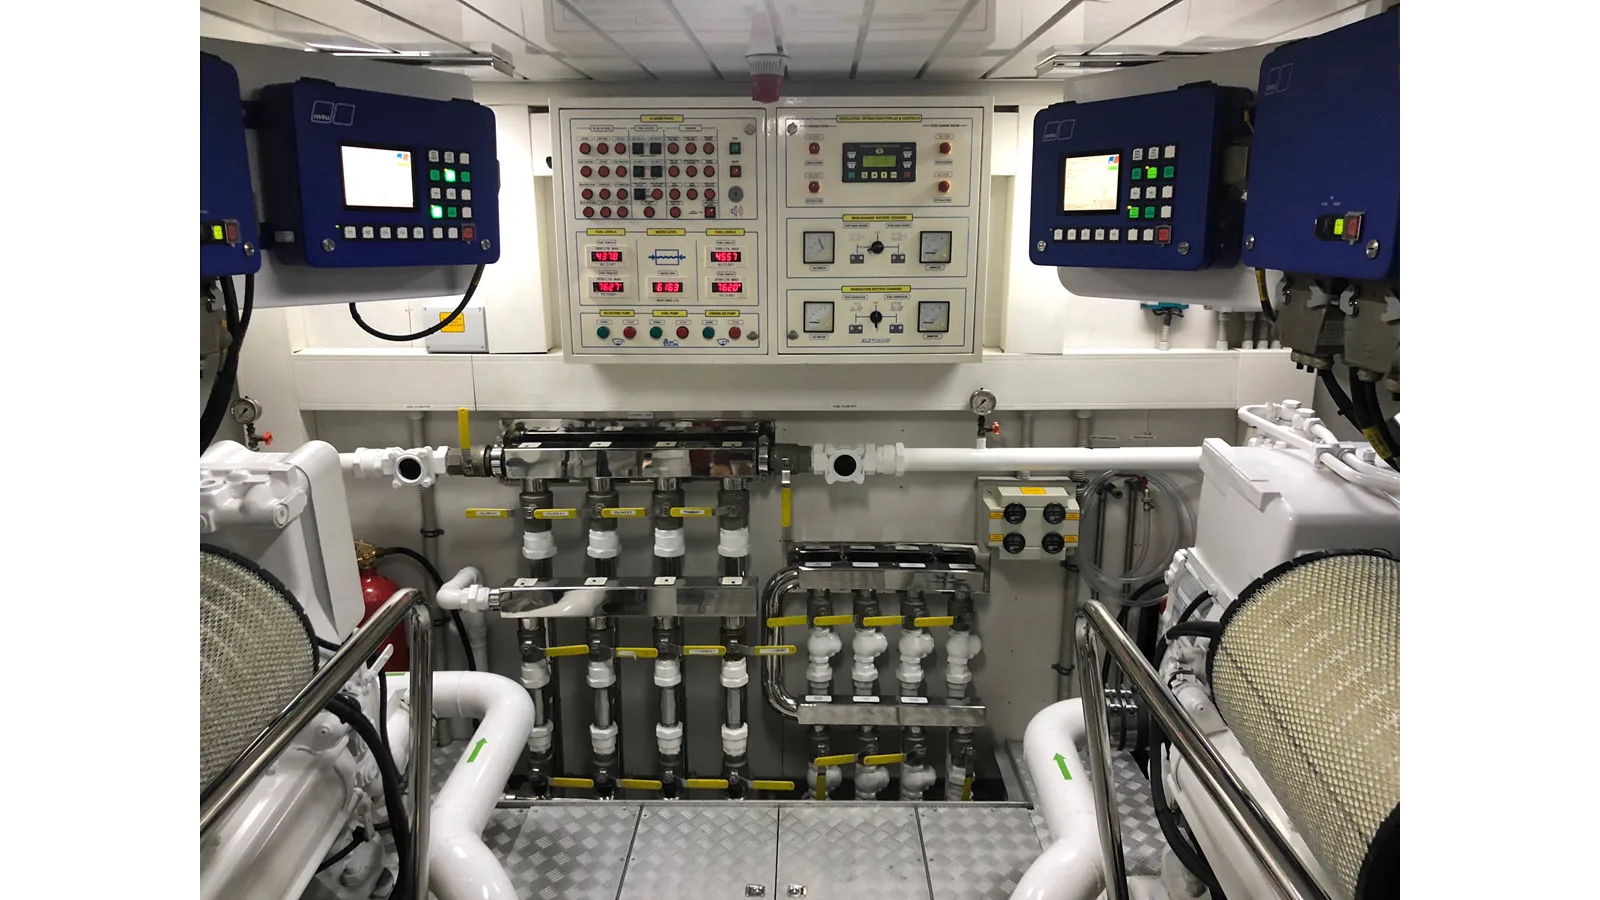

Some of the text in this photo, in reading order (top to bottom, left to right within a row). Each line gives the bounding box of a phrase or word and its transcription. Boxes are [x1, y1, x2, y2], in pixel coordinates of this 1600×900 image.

[595, 252, 618, 261] 4378
[715, 252, 738, 261] 4557
[600, 283, 621, 291] 7627
[656, 283, 679, 292] 6163
